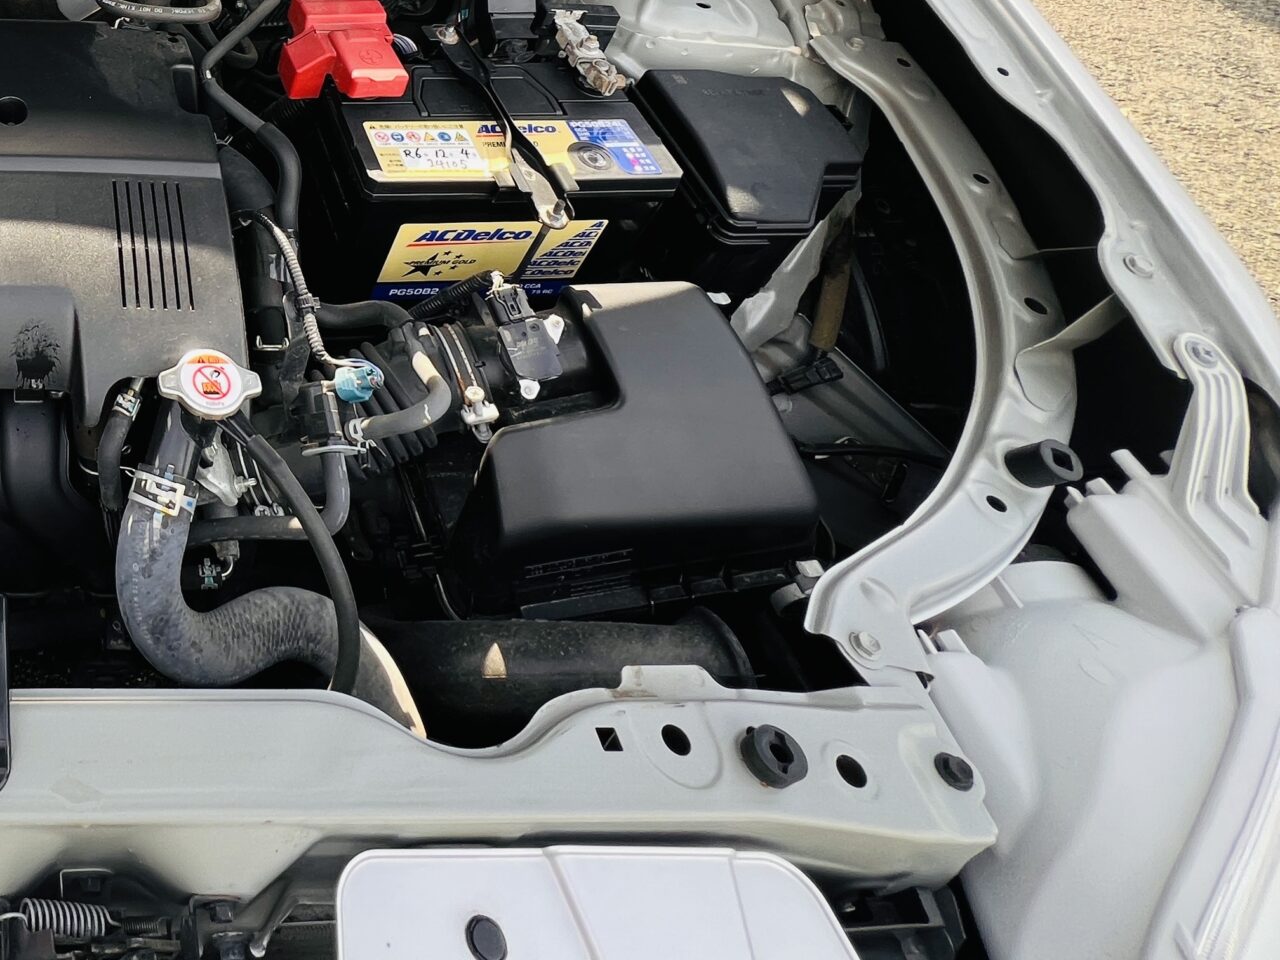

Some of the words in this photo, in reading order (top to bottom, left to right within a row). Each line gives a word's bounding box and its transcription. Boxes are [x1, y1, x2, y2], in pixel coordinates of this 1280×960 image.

[476, 123, 557, 135] ACelco
[413, 229, 533, 243] ACDelco
[451, 258, 477, 266] GOLD
[388, 287, 440, 296] PG50B2
